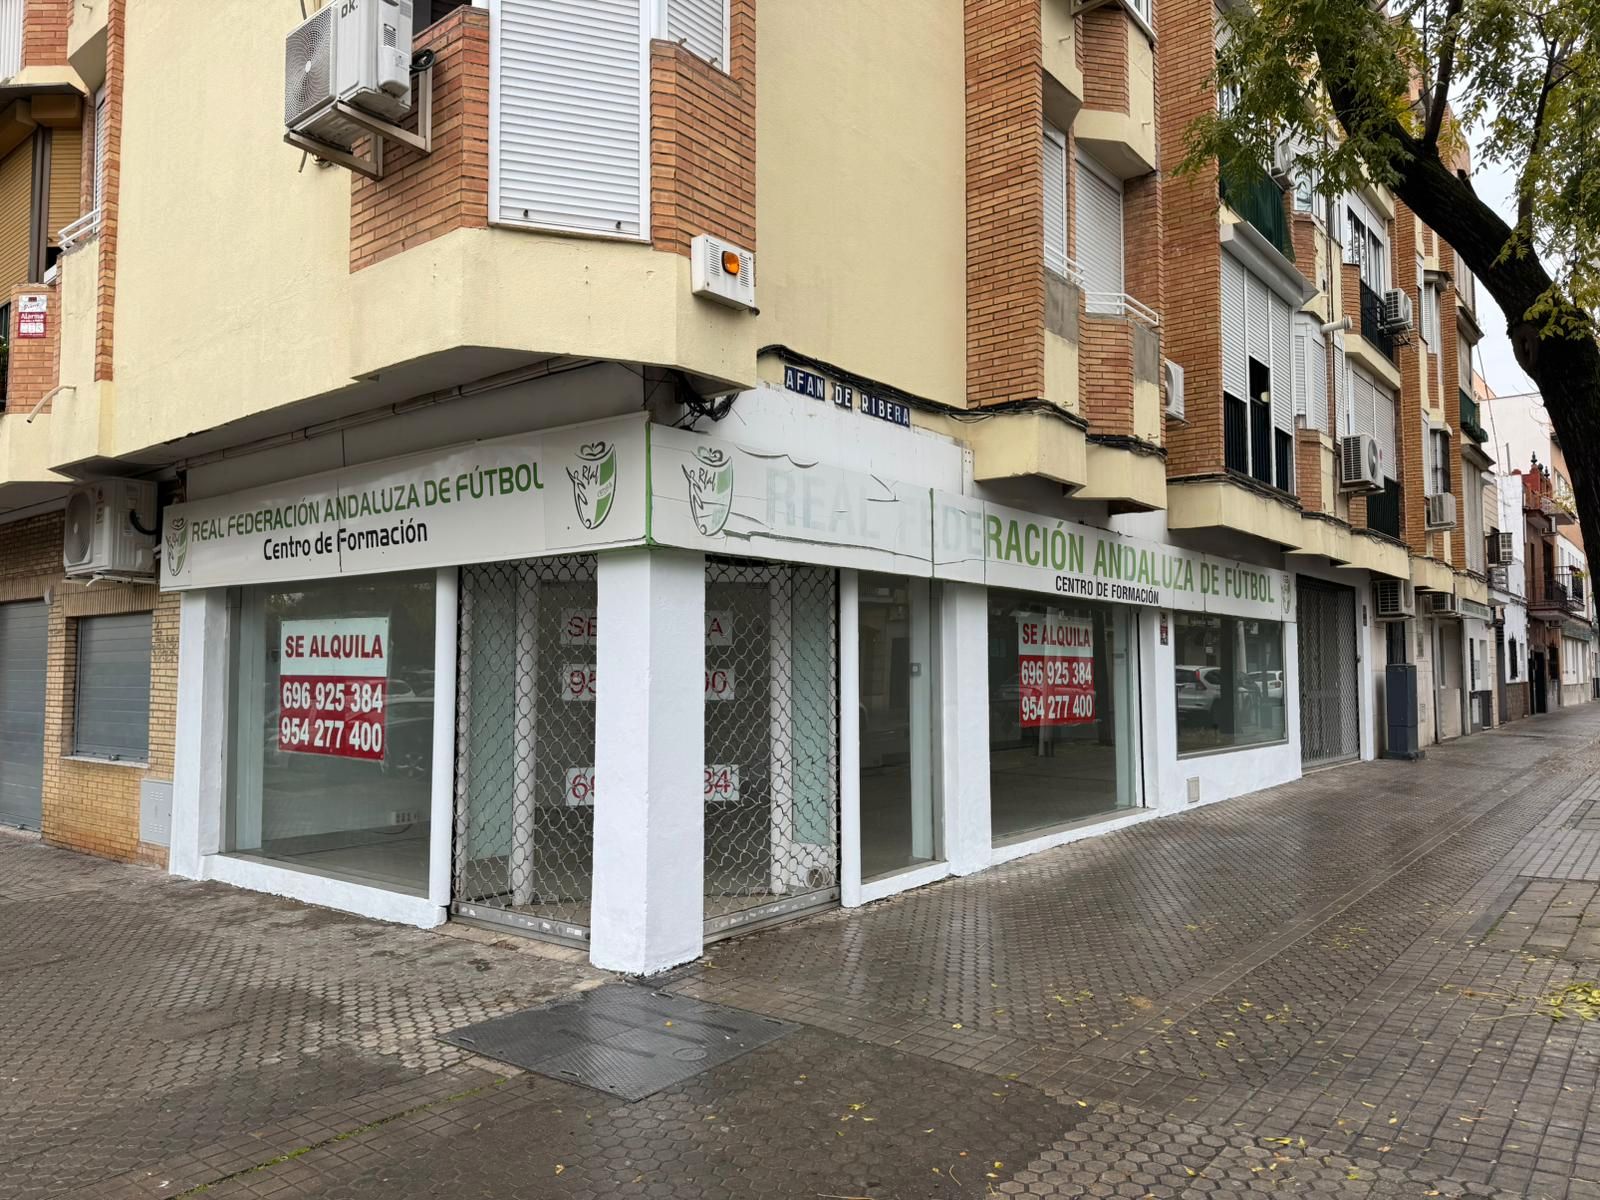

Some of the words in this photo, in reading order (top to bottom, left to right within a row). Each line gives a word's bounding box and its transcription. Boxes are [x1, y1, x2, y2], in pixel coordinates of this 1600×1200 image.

[786, 370, 824, 398] AFAN
[835, 384, 851, 407] DE
[862, 394, 909, 425] RIBERA
[192, 518, 225, 542] REAL
[227, 497, 319, 537] FEDERACIÓN
[324, 483, 420, 522] ANDALUZA
[424, 477, 451, 506] DE
[456, 462, 544, 502] FÚTBOL
[264, 536, 311, 560] Centro
[315, 531, 333, 555] de
[337, 518, 427, 552] Formación
[766, 469, 880, 539] REAL
[1093, 540, 1194, 592] ANDALUZA
[1200, 562, 1219, 595] DE
[1225, 563, 1274, 603] FÚTBOL
[1056, 576, 1093, 596] CENTRO
[1097, 581, 1108, 597] DE
[1111, 585, 1159, 605] FORMACIÓN
[285, 635, 304, 658] SE
[309, 635, 383, 659] ALQUILA
[1022, 623, 1037, 645] SE
[1041, 625, 1090, 647] ALQUILA
[1021, 661, 1043, 685] 696
[1047, 661, 1069, 685] 925
[1072, 662, 1092, 685] 384
[283, 682, 310, 709] 696
[315, 682, 345, 711] 925
[350, 683, 383, 713] 384
[1022, 696, 1044, 721] 954
[1048, 695, 1069, 719] 277
[1072, 694, 1092, 717] 400
[281, 717, 309, 745] 954
[314, 719, 344, 748] 277
[349, 721, 382, 752] 400
